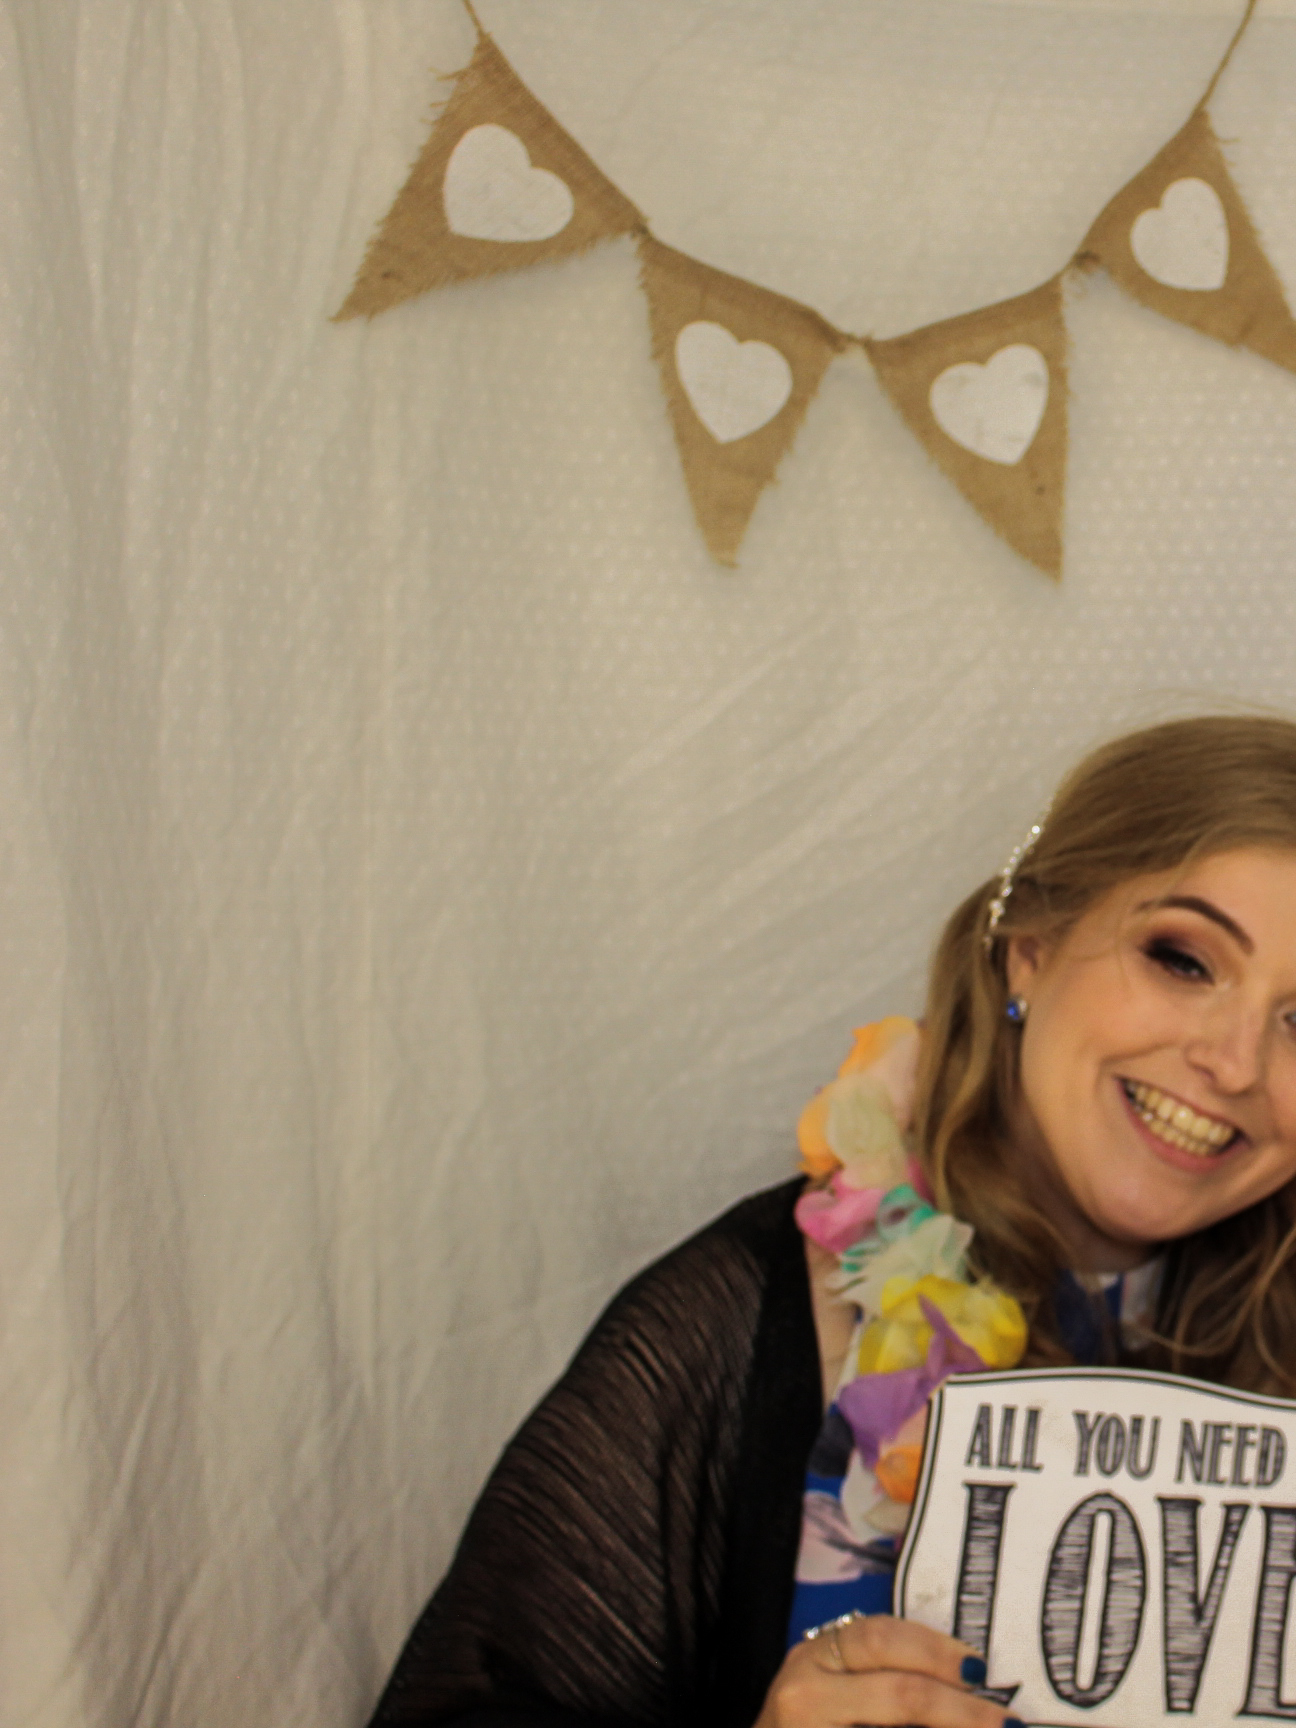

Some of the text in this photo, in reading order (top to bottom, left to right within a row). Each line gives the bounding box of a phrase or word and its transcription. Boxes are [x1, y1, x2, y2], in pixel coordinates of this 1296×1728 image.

[965, 1403, 1043, 1471] ALL
[1073, 1409, 1160, 1480] YOU
[1175, 1419, 1287, 1486] NEED
